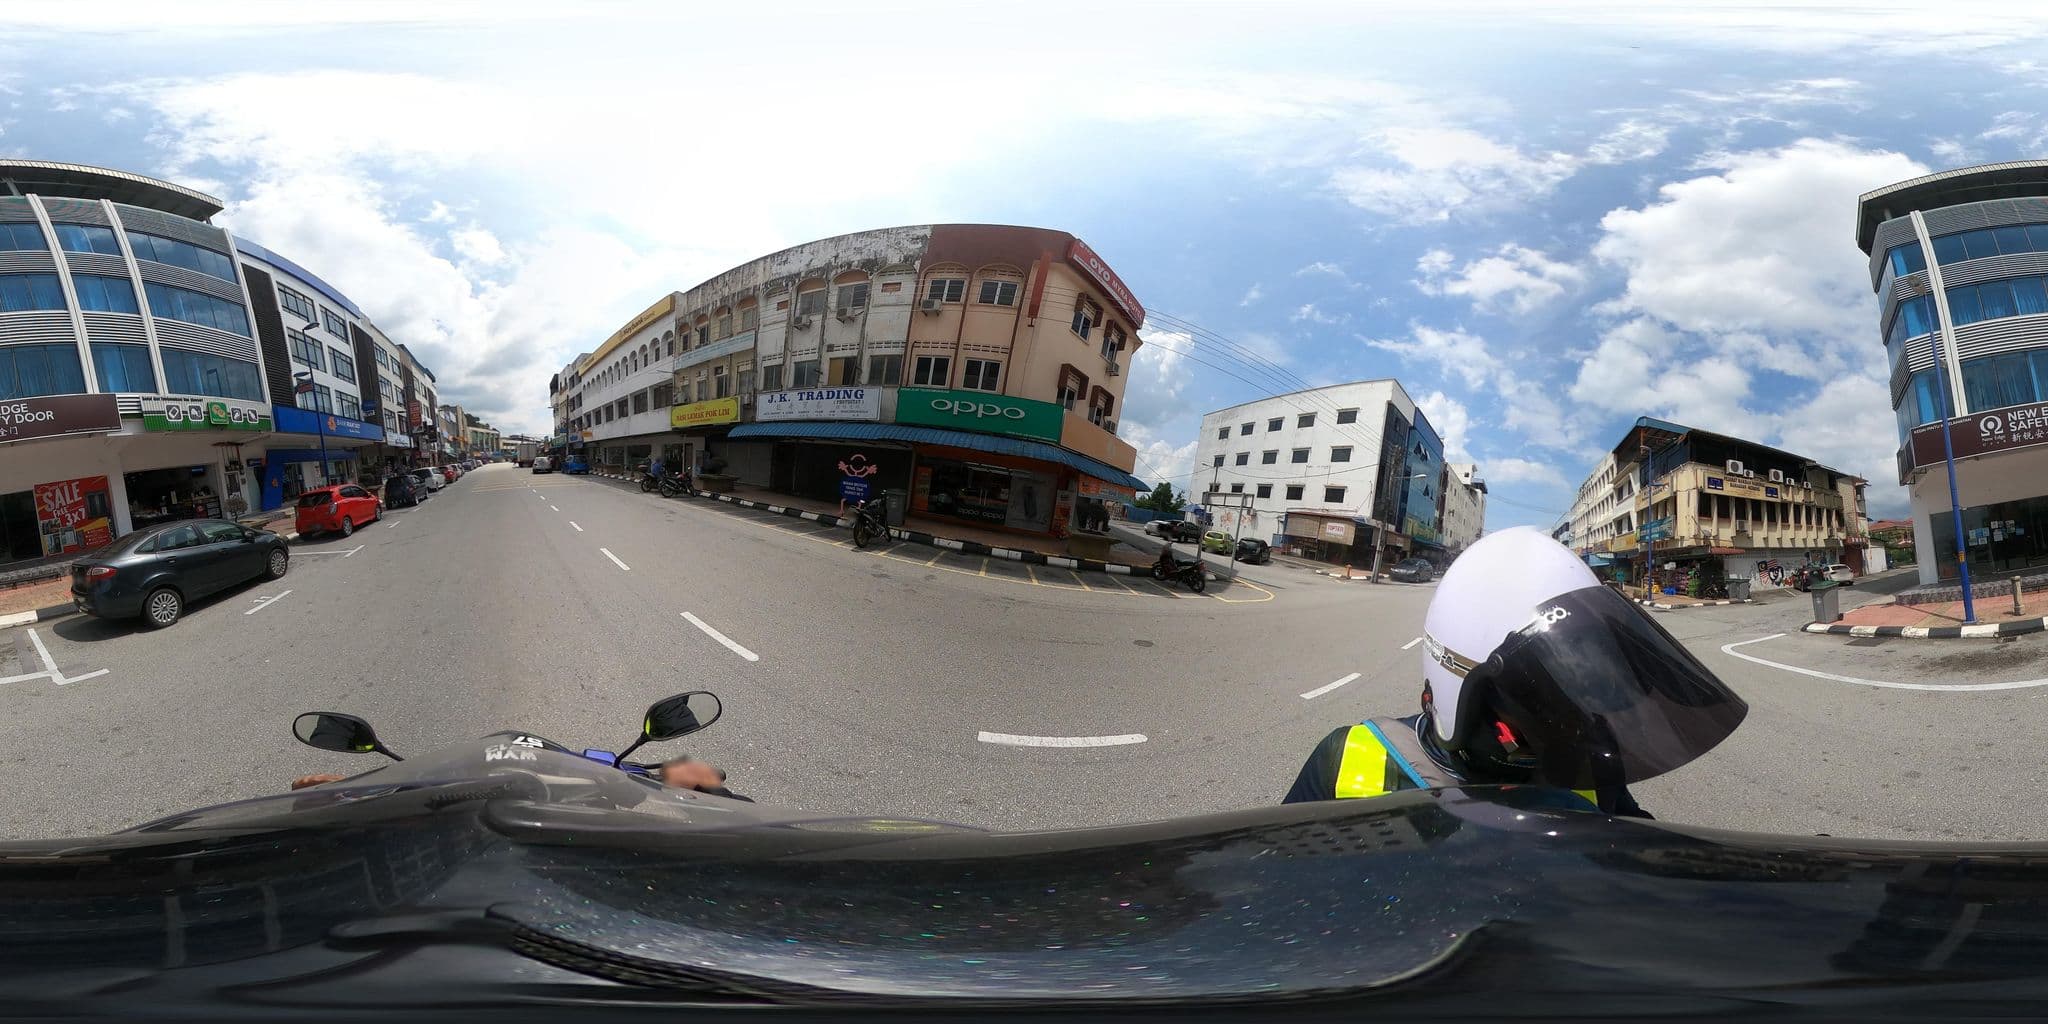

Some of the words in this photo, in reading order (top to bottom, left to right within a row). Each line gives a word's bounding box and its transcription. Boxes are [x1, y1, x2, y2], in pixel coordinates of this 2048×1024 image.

[1089, 257, 1111, 282] OYO
[768, 393, 791, 404] J.K.
[797, 389, 865, 401] TRADING
[15, 410, 55, 424] DOOR
[931, 399, 1026, 419] oppo
[2007, 408, 2037, 422] NEW
[43, 481, 82, 512] SALE
